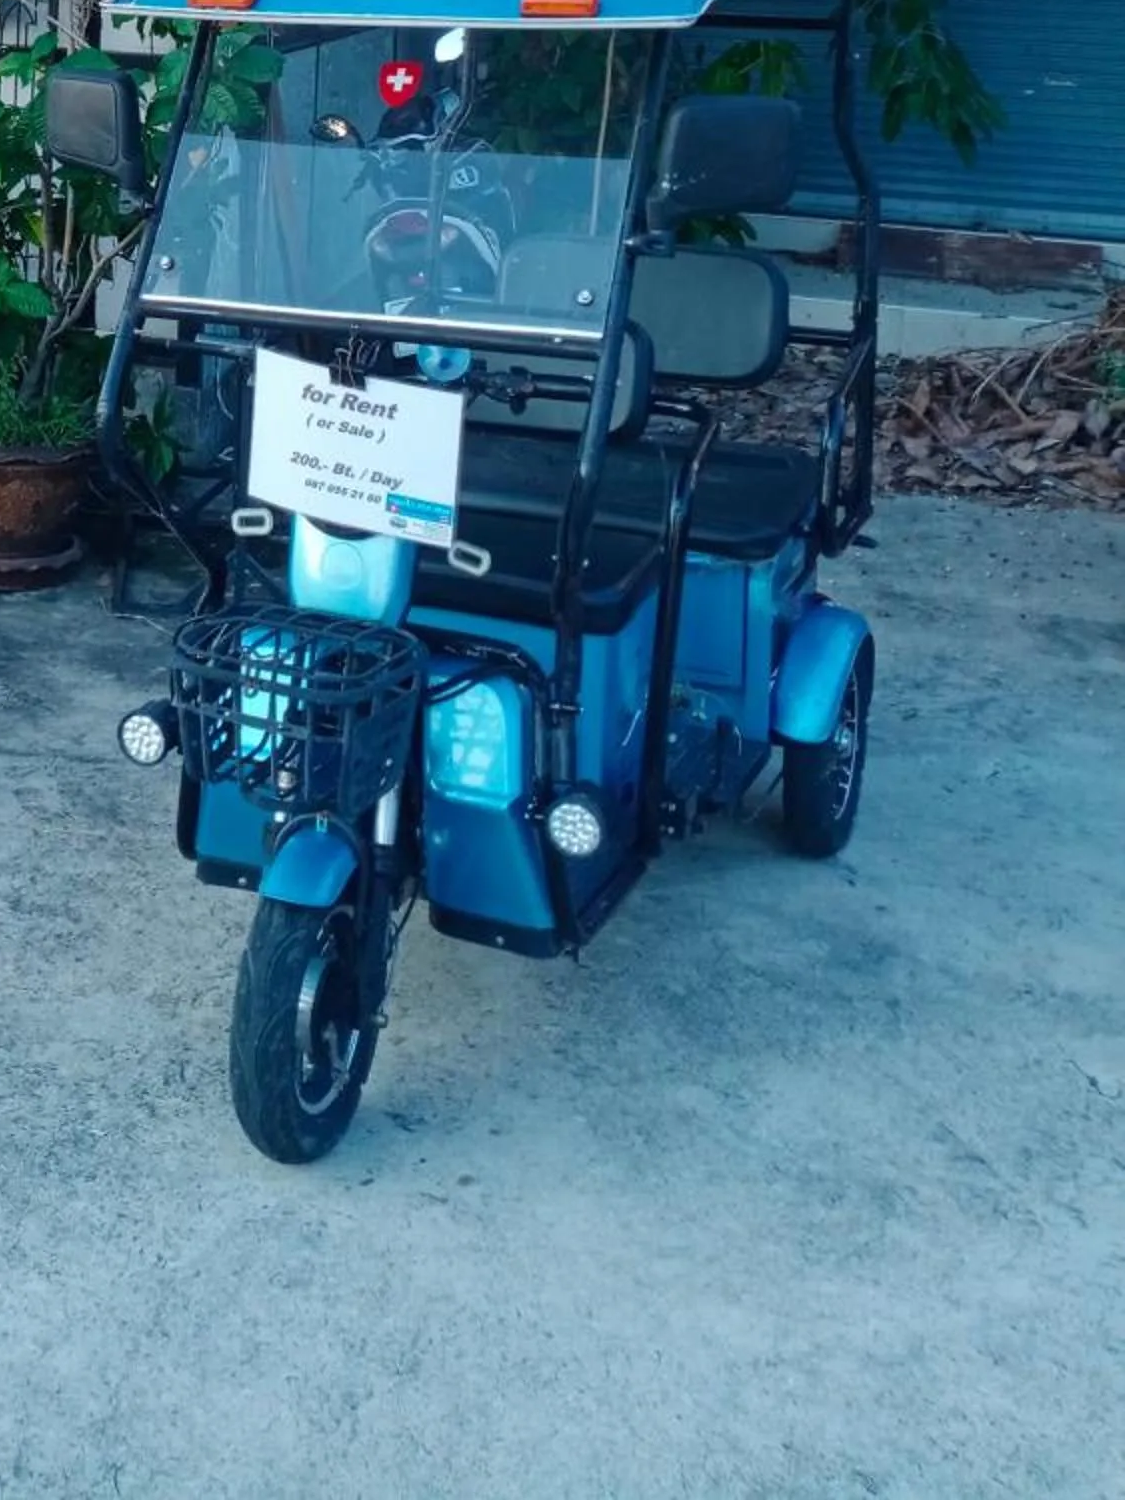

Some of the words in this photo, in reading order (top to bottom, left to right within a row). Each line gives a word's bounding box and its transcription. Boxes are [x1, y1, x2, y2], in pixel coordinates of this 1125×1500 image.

[302, 383, 336, 406] for
[340, 392, 399, 420] Rent
[339, 421, 374, 439] Sale
[370, 471, 404, 491] Day
